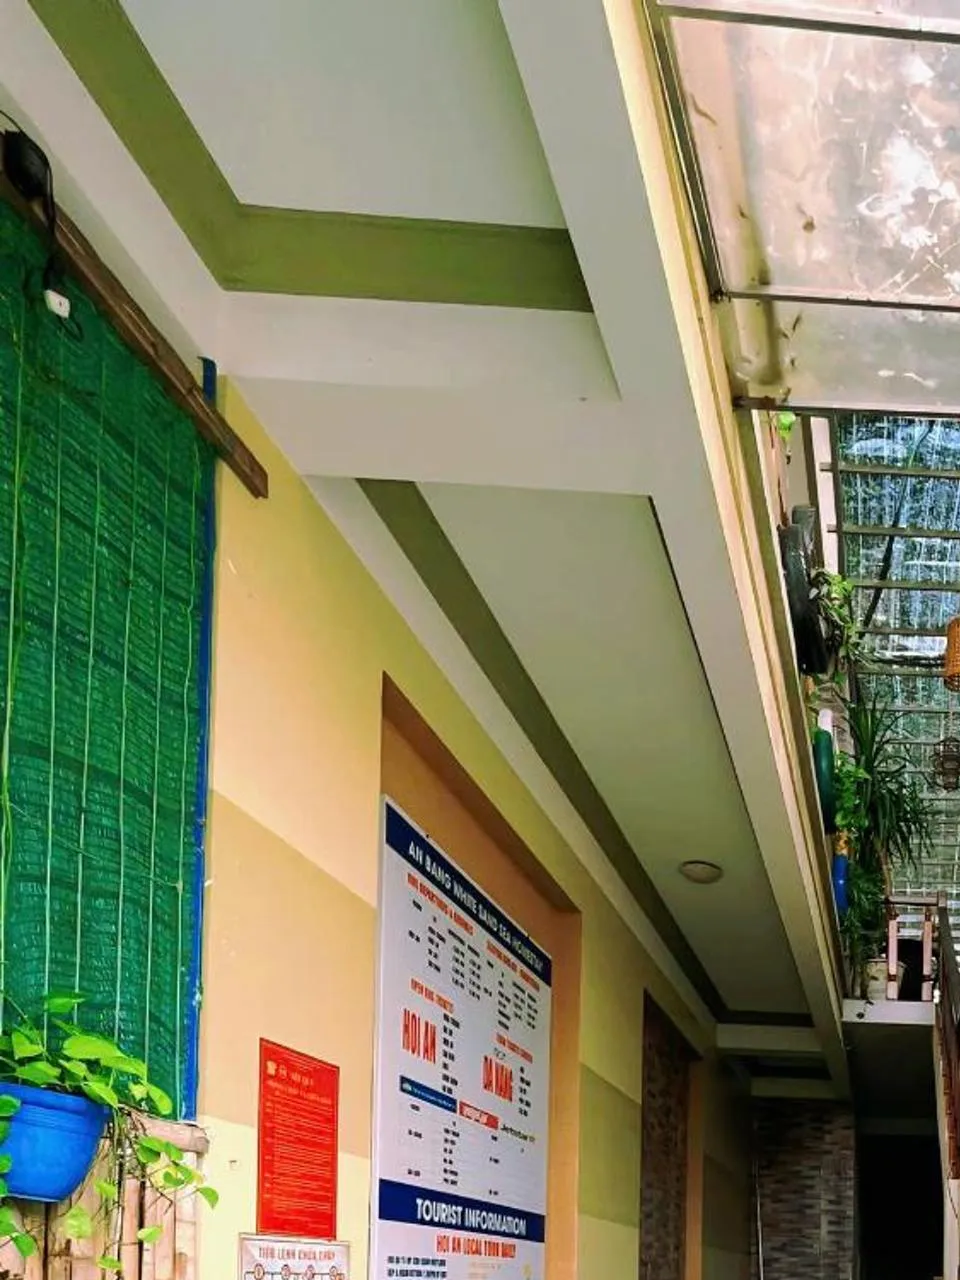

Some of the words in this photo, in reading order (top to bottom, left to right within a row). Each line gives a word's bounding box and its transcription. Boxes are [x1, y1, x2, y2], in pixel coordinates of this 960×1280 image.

[408, 840, 423, 866] AN
[425, 854, 452, 890] BANG
[402, 1008, 421, 1057] HOI
[422, 1020, 437, 1065] AN
[416, 1198, 462, 1226] TOURIST
[465, 1207, 527, 1235] INFORMATION
